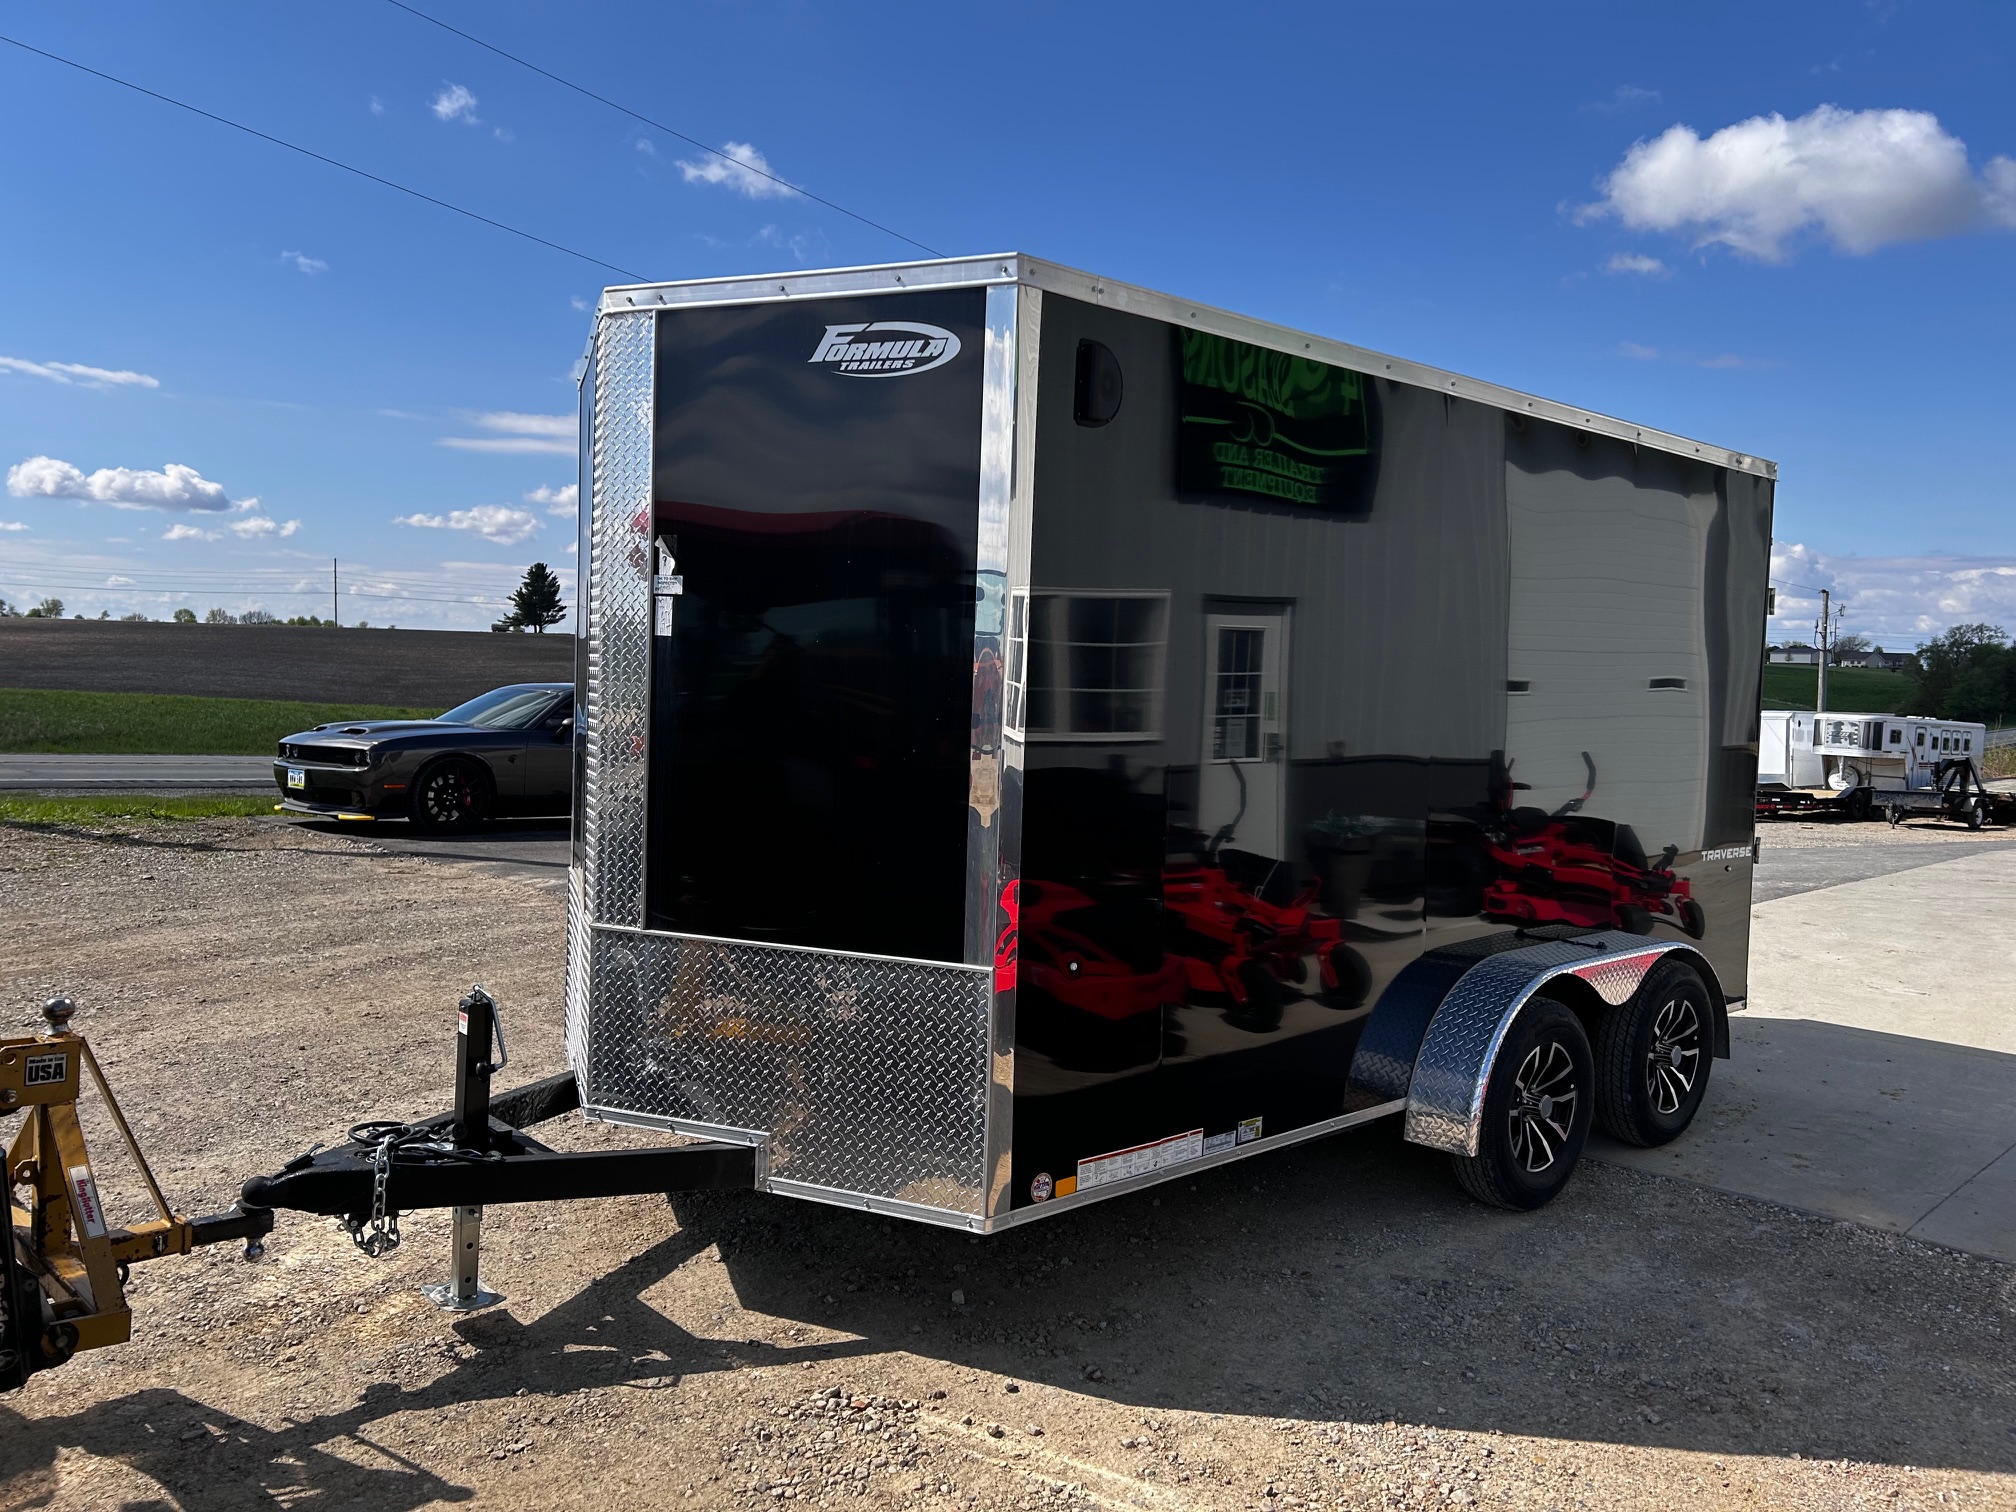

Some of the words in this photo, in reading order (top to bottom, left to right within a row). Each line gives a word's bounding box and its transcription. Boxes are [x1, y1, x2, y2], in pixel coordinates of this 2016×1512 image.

[807, 323, 948, 363] FORMULA
[839, 360, 915, 371] TRAILERS
[1701, 846, 1752, 861] TRAVERSE
[28, 1062, 65, 1082] USA
